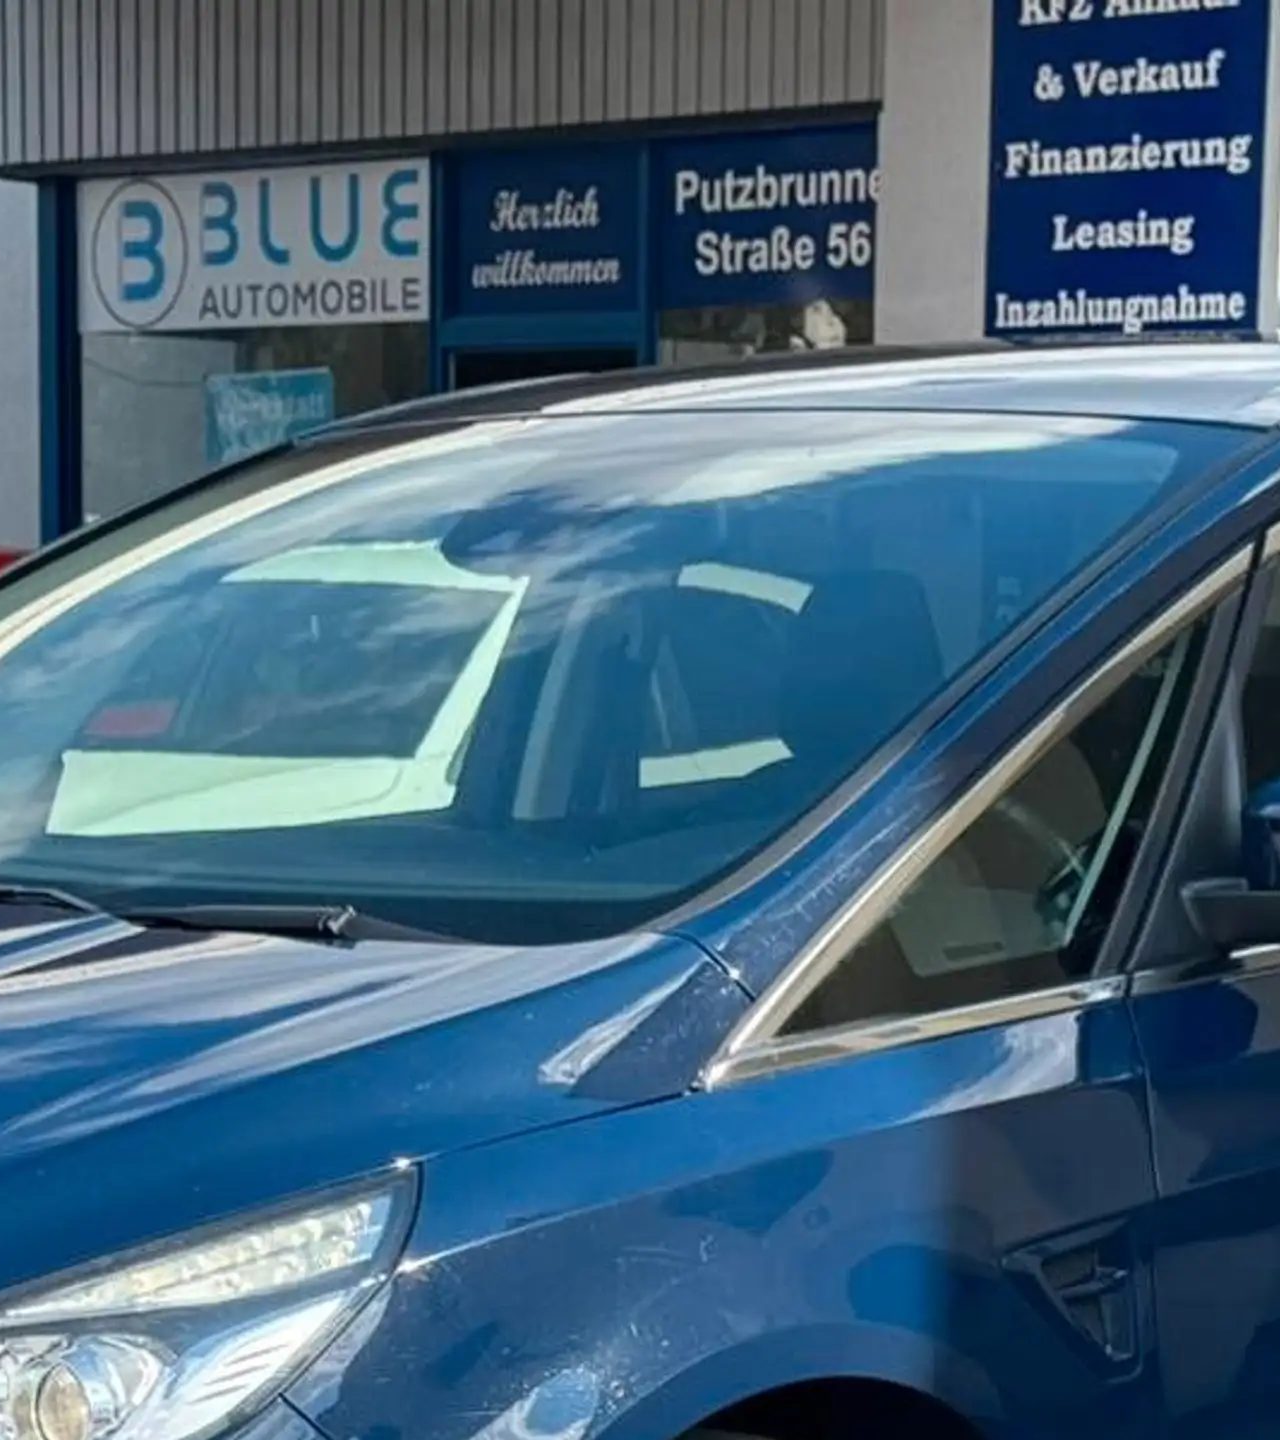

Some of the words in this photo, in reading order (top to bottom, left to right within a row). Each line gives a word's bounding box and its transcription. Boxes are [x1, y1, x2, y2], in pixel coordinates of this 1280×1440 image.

[1033, 63, 1065, 101] &
[1072, 48, 1226, 98] Verkauf
[1004, 132, 1253, 178] Finanzierung
[200, 168, 420, 267] BLUE
[488, 184, 602, 233] Herzlich
[1051, 208, 1195, 255] Leasing
[471, 248, 622, 290] willkommen
[694, 224, 816, 277] Straße
[826, 219, 872, 269] 56
[197, 277, 421, 322] AUTOMOBILE
[994, 284, 1247, 335] Inzahlungnahme
